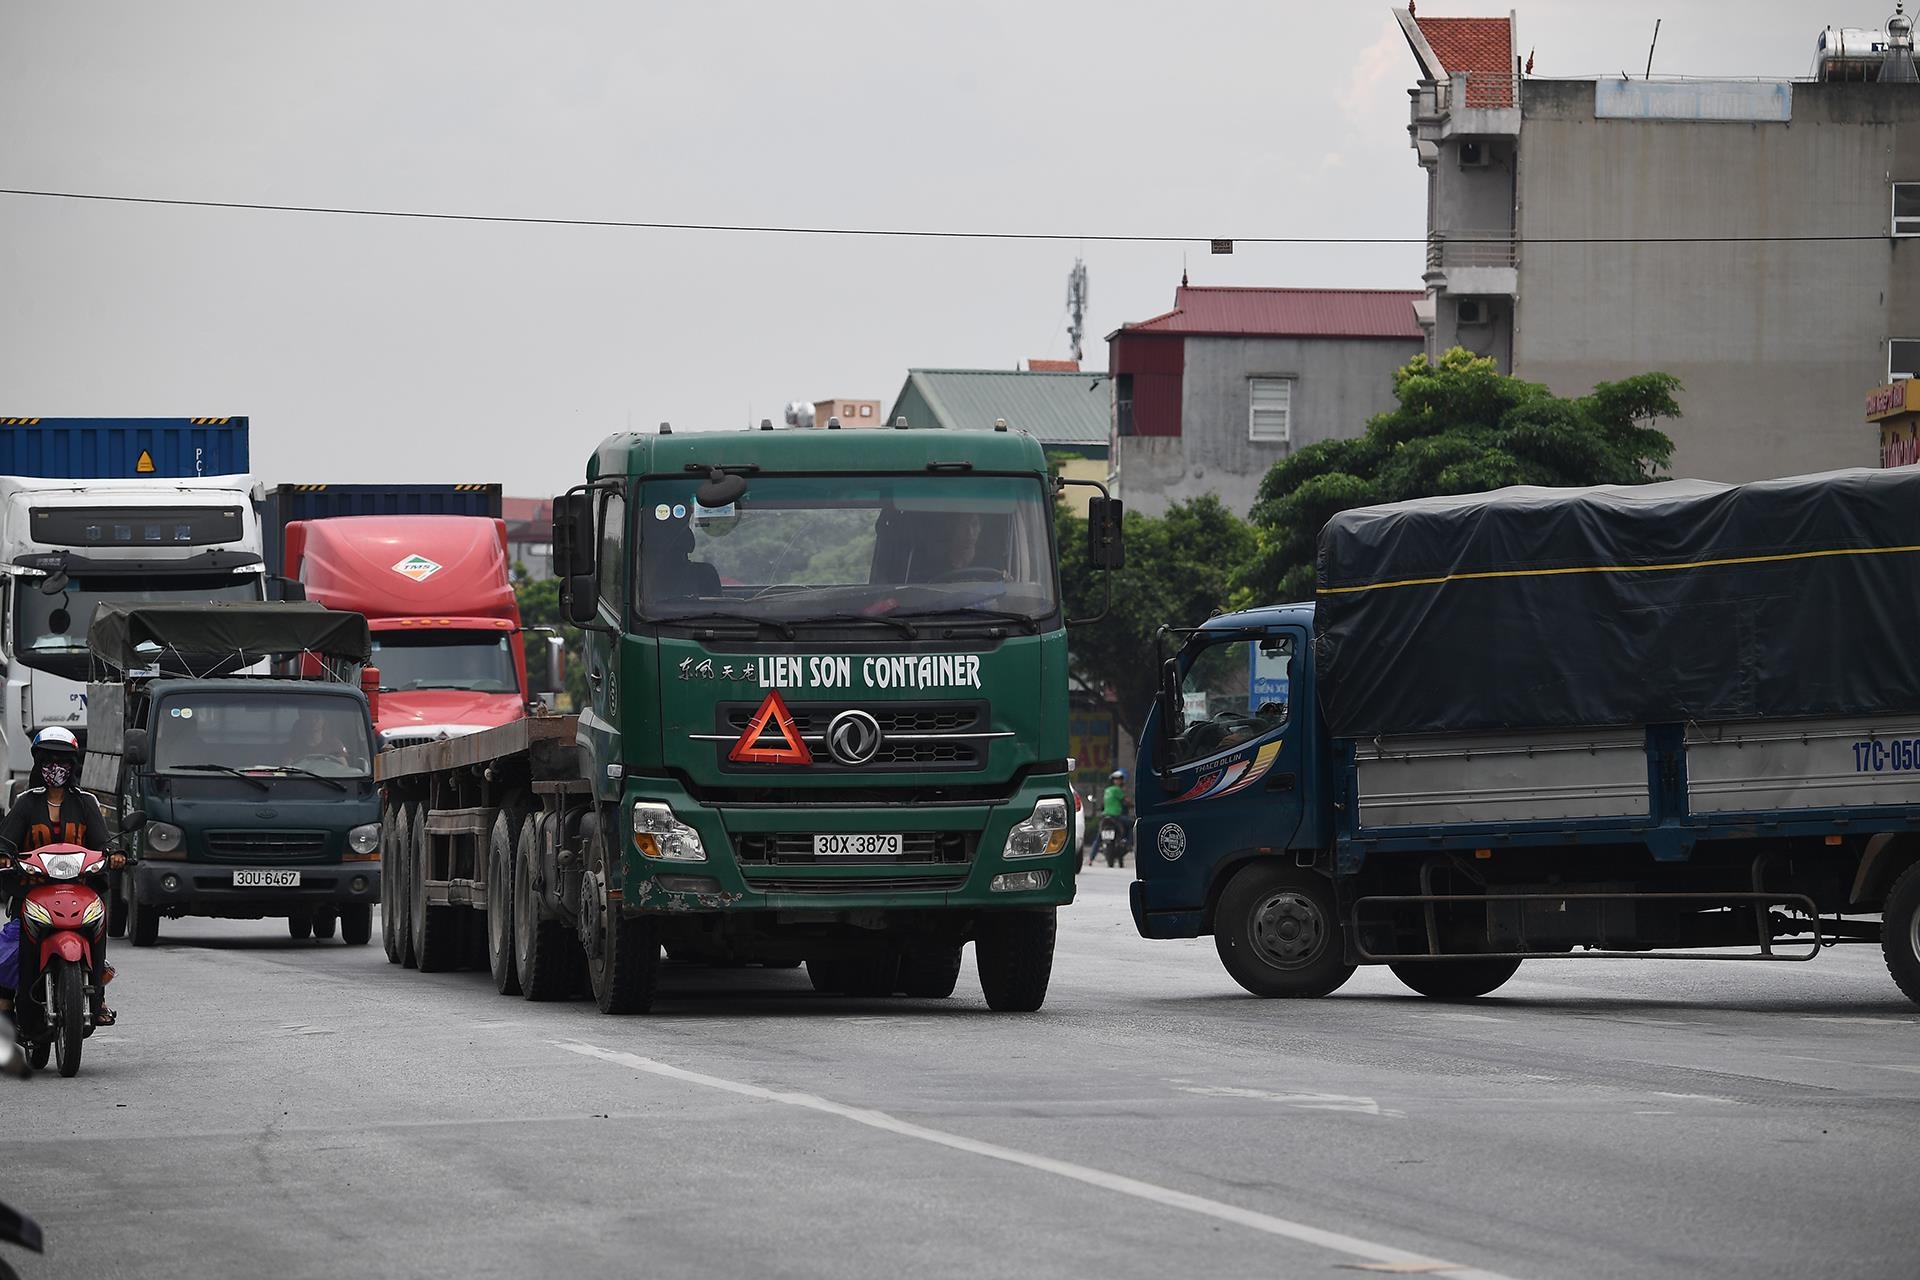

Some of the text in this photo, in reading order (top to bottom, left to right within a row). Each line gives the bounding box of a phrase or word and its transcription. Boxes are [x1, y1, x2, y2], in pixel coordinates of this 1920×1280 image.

[758, 655, 981, 690] LIEN SON CONTAINER
[1195, 753, 1242, 773] THACO OLLIN
[818, 835, 898, 854] 30X-3879
[237, 872, 297, 885] 30U-6467
